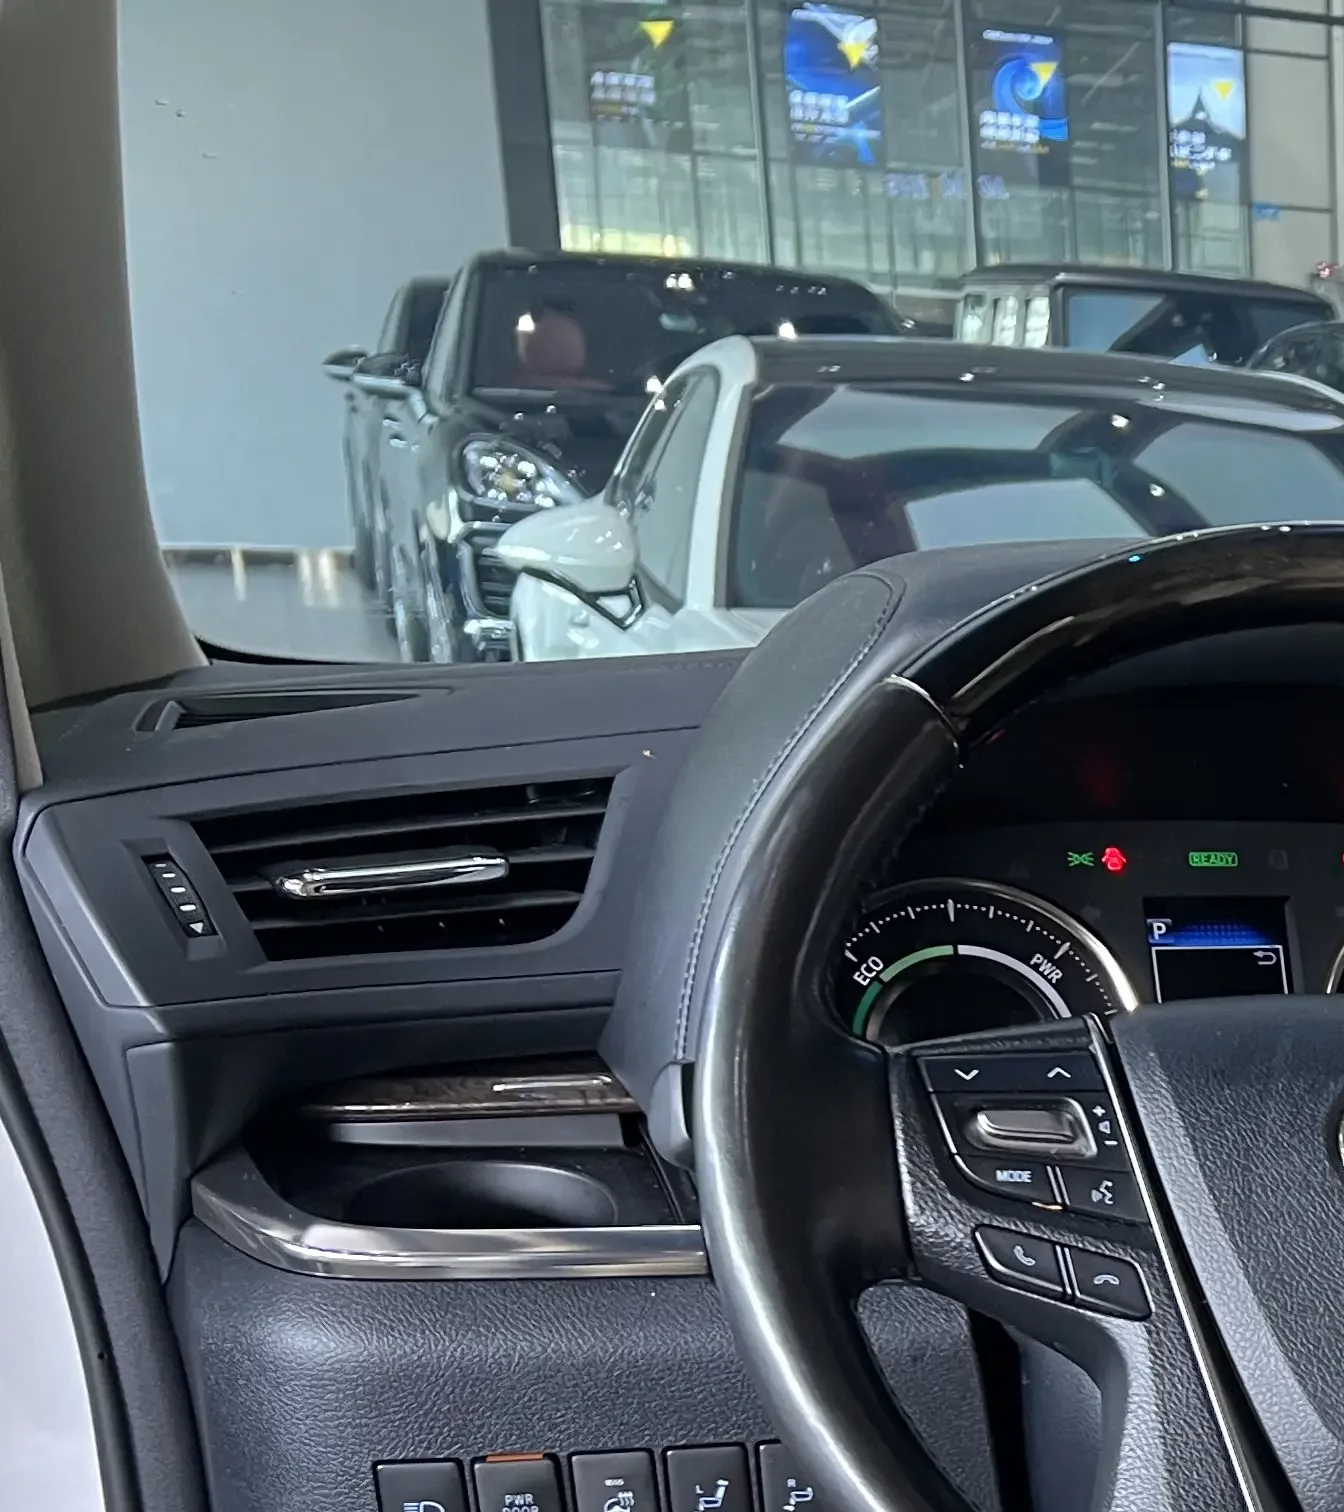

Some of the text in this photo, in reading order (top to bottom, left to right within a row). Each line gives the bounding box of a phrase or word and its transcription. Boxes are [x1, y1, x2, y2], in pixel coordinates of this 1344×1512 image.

[1191, 853, 1236, 865] READY
[1152, 922, 1167, 940] P
[852, 956, 884, 986] ECO
[1029, 953, 1063, 984] PWR
[995, 1169, 1032, 1182] MODE
[504, 1493, 534, 1506] PWR
